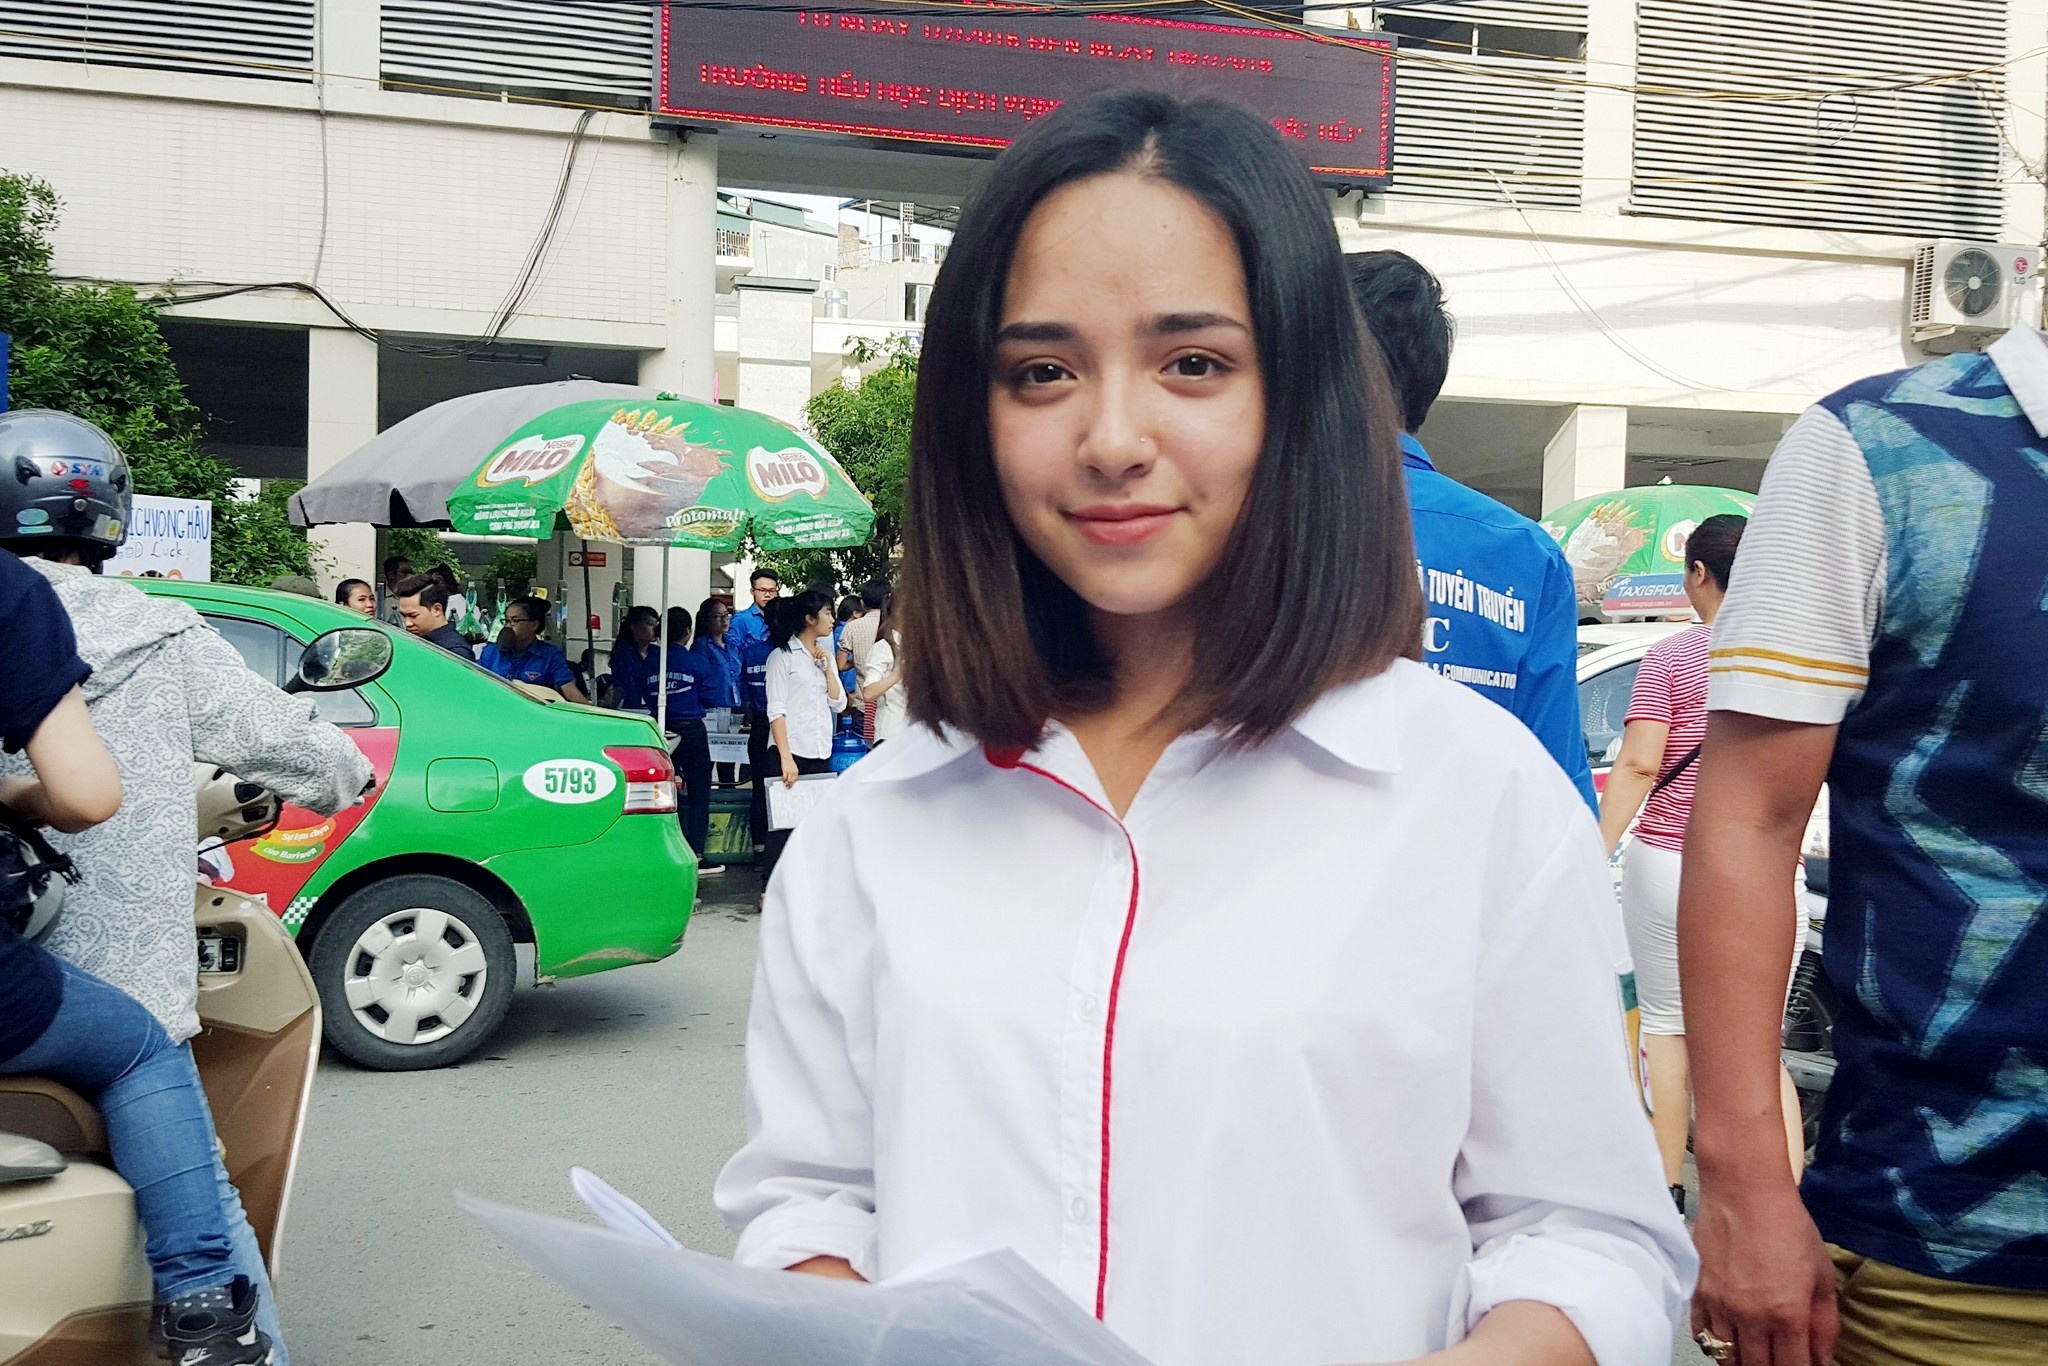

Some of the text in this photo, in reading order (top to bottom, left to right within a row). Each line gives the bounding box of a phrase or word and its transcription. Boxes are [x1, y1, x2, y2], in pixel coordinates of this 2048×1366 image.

[492, 449, 570, 474] MILO
[755, 462, 820, 488] MILO
[665, 507, 746, 528] Protomalt
[1428, 569, 1474, 613] TUYÊN
[1475, 583, 1525, 633] TRUYỀN
[1618, 583, 1686, 597] TAXIGROU
[545, 767, 596, 794] 5793
